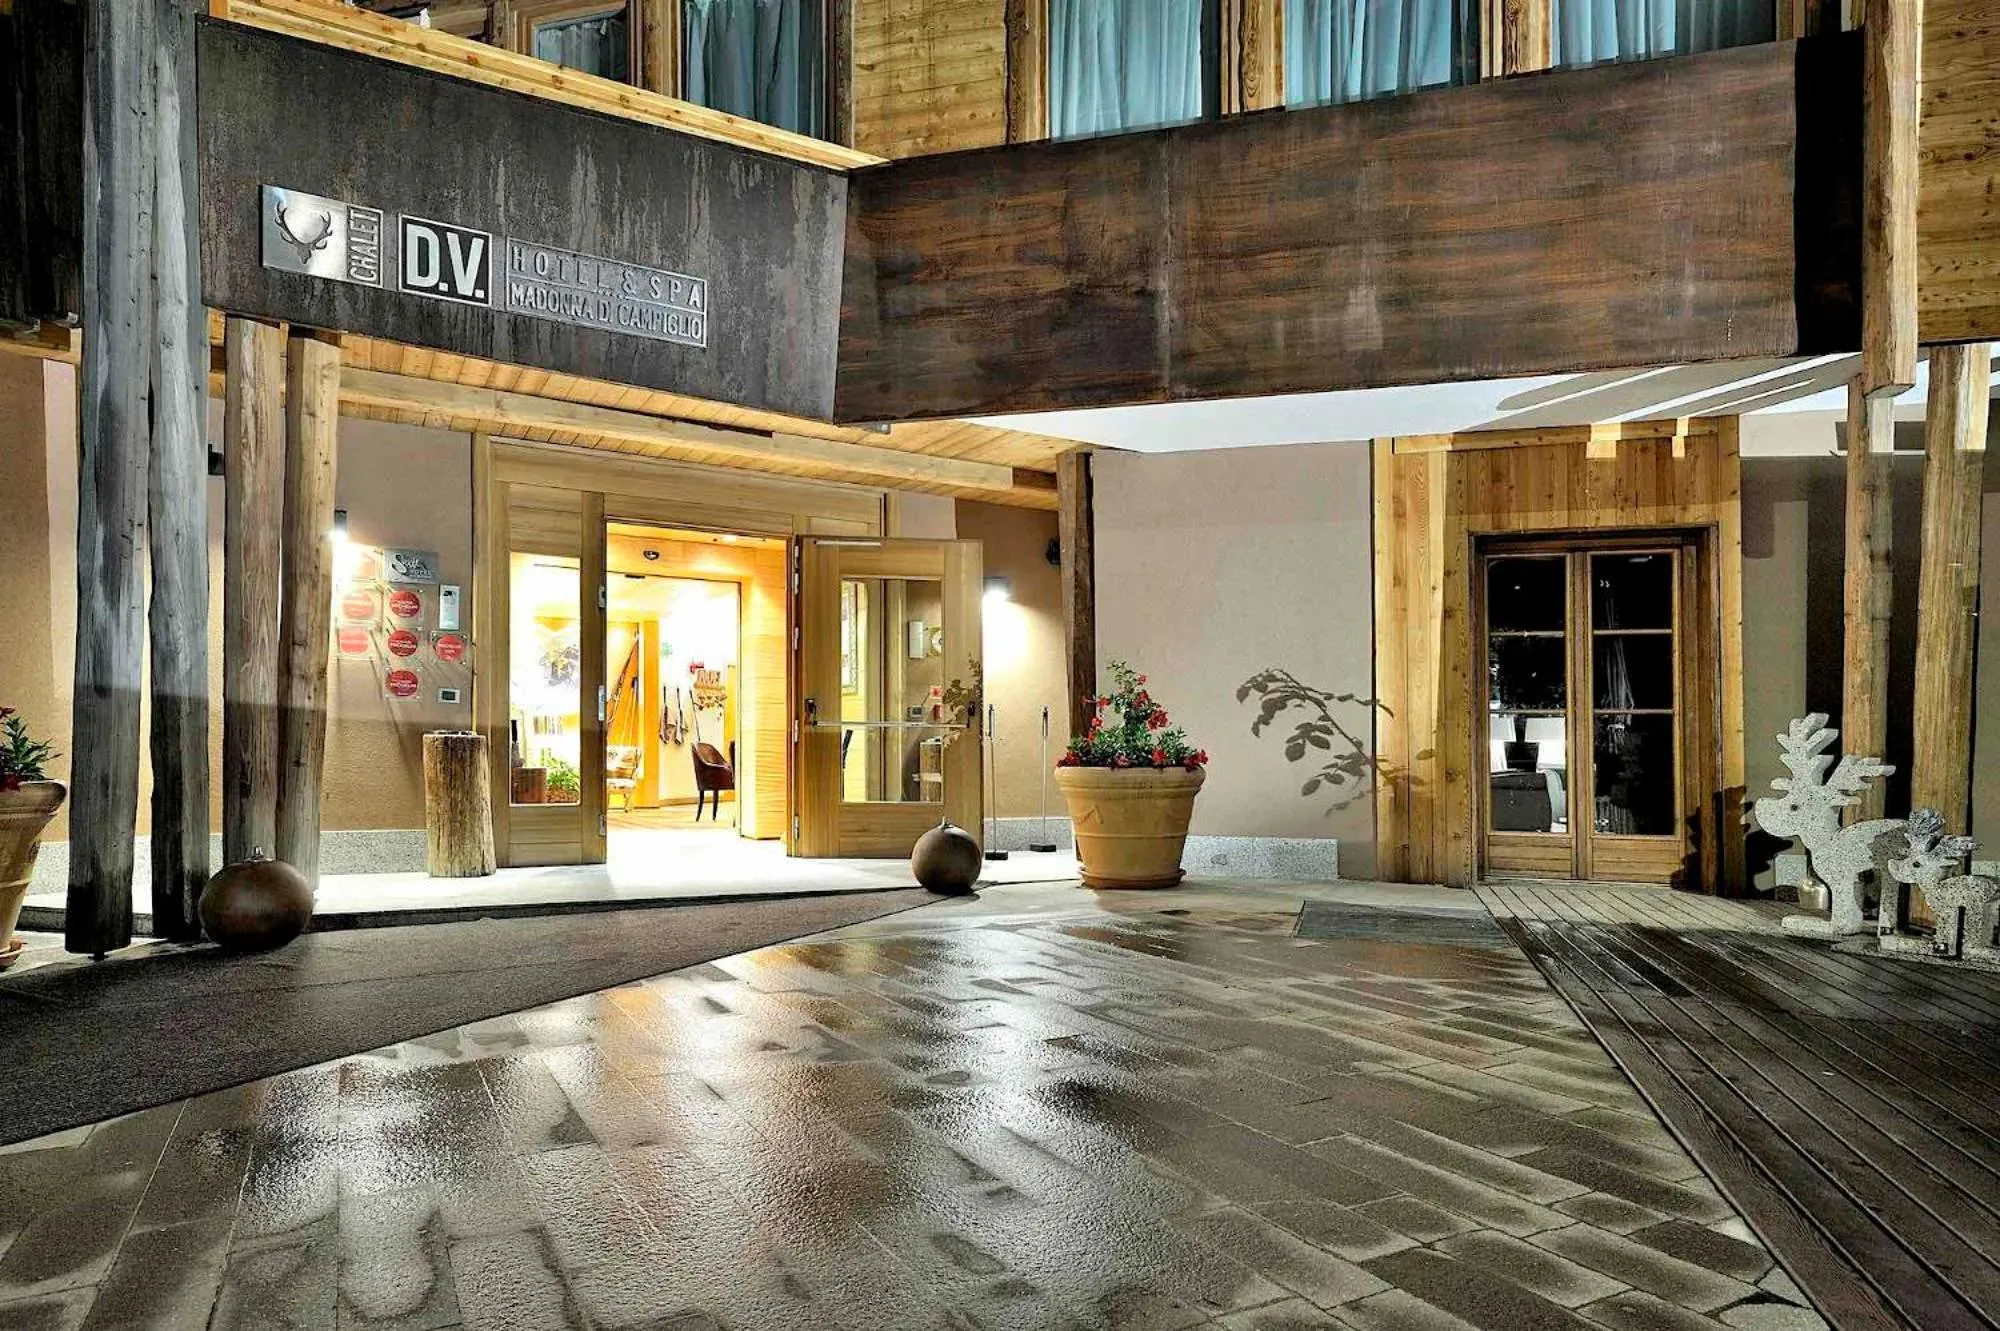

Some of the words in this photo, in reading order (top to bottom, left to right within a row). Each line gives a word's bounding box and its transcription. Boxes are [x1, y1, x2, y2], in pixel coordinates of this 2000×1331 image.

[348, 208, 379, 282] CHALET
[405, 223, 485, 299] D.V.
[512, 245, 610, 289] HOTEL
[622, 269, 637, 296] &
[649, 274, 702, 309] SPA
[510, 282, 594, 321] MADONNA
[616, 303, 703, 340] CAMPIGLIO
